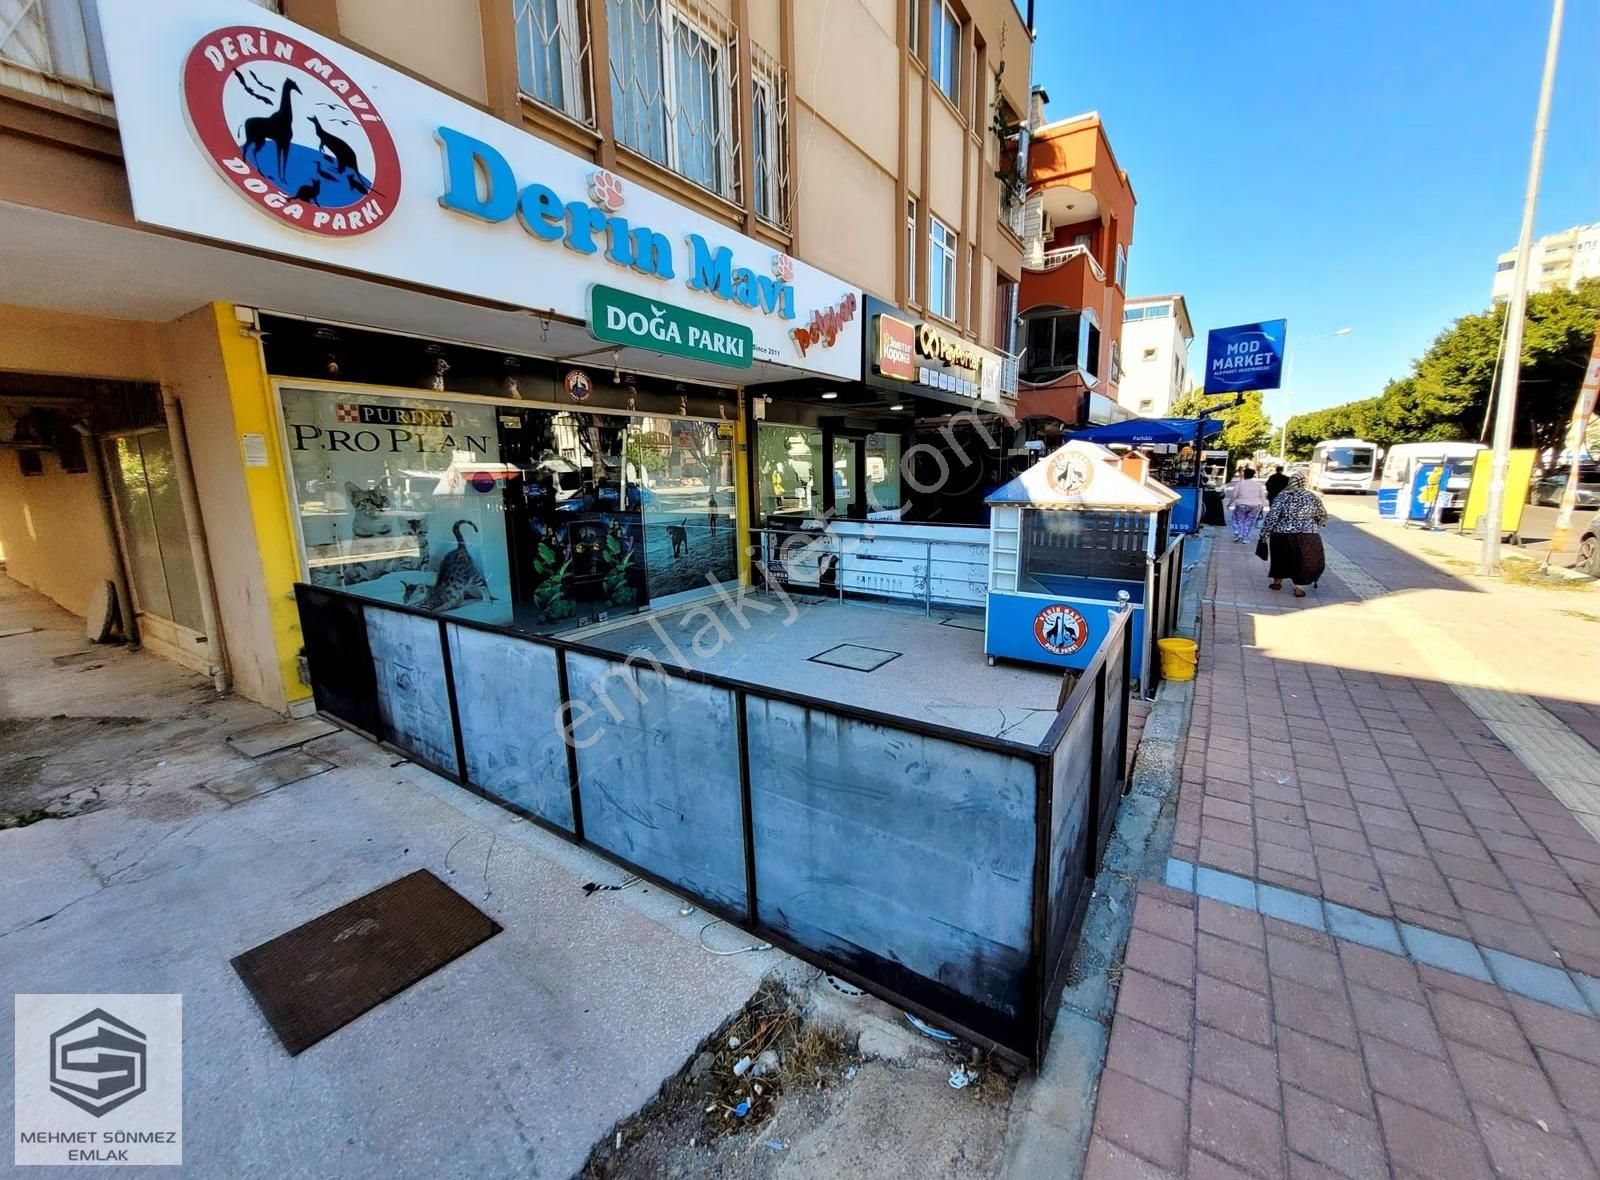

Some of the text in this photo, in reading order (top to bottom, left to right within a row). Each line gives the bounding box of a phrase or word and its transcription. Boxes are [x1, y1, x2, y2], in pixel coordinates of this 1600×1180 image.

[204, 30, 294, 72] DERİN
[222, 156, 385, 232] DOĞA PARKI
[433, 126, 796, 320] Derin Mavi
[606, 303, 744, 358] DOĞA PARKI
[768, 346, 780, 357] 2011
[883, 343, 911, 365] Корона
[1212, 352, 1274, 370] MARKET
[1227, 340, 1260, 356] MOD
[363, 408, 450, 426] PURINA
[289, 424, 380, 452] PRO
[386, 428, 490, 454] PLAN
